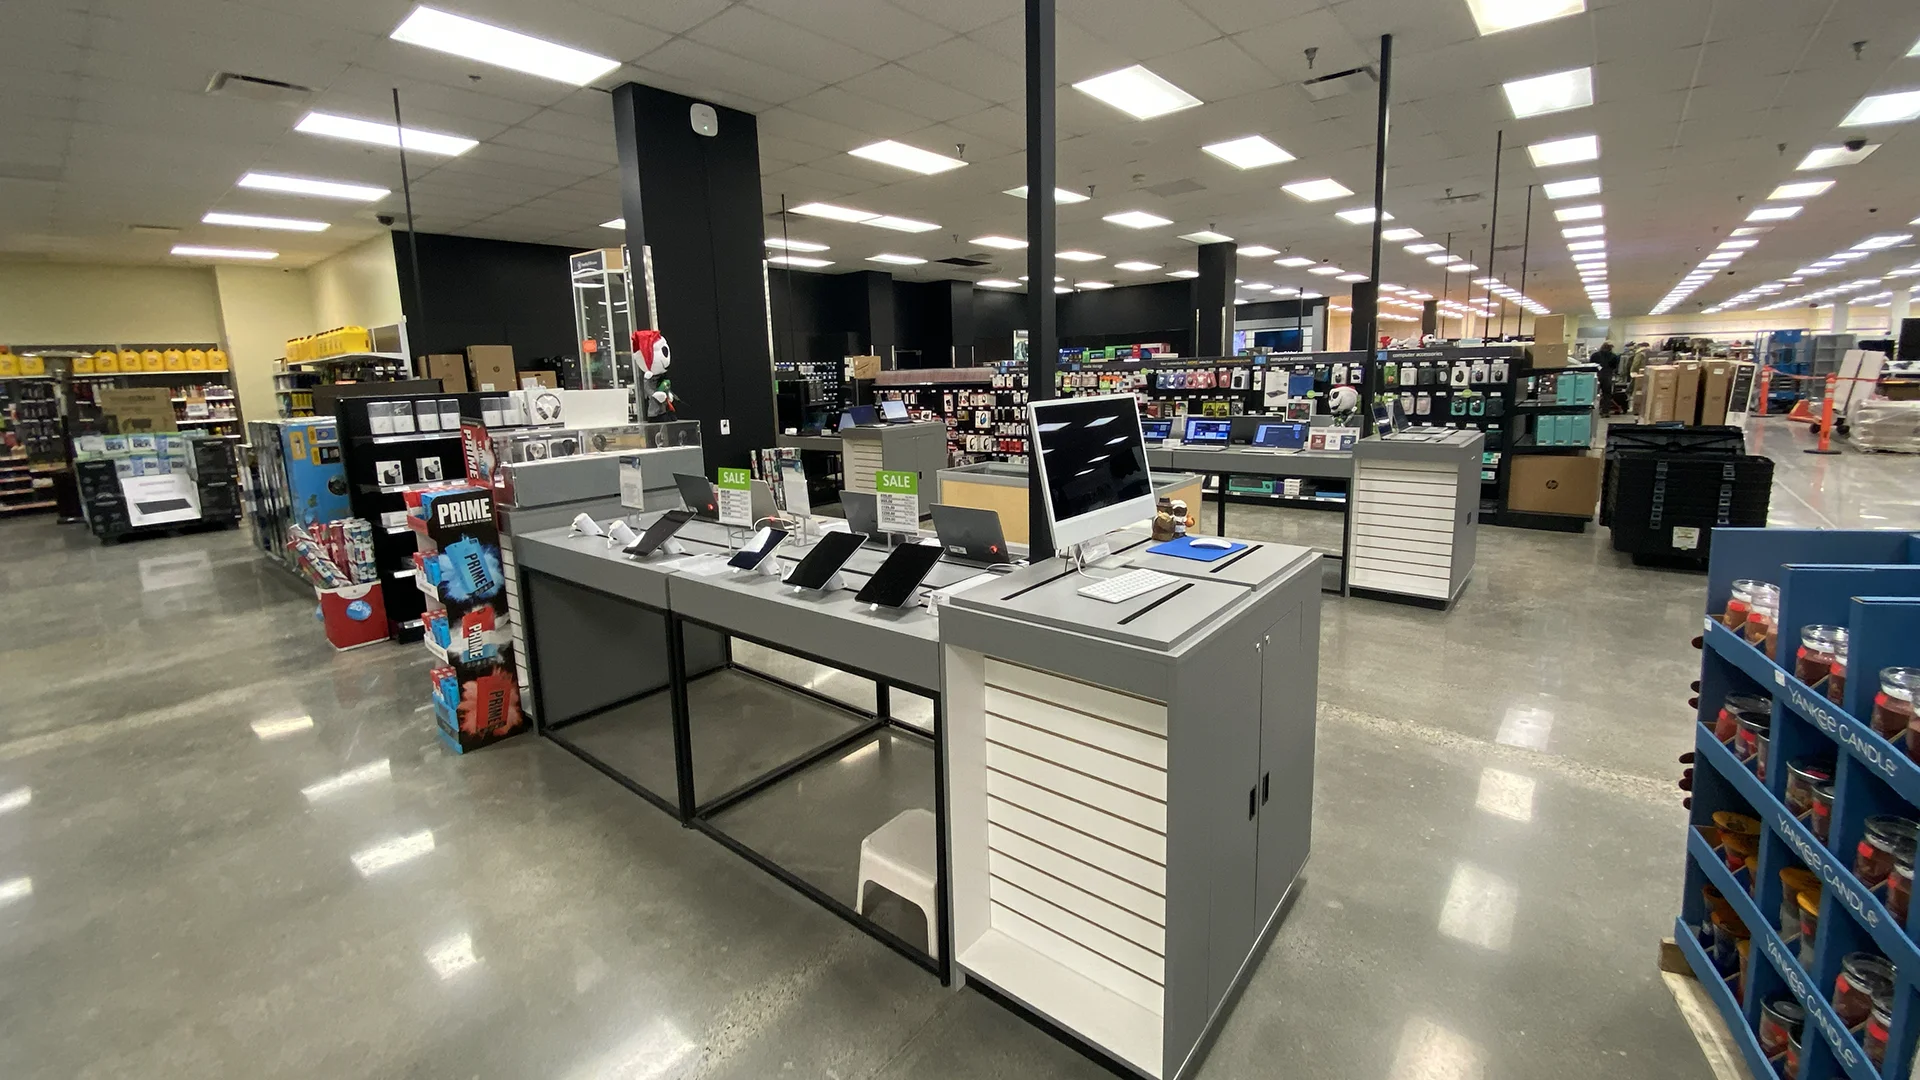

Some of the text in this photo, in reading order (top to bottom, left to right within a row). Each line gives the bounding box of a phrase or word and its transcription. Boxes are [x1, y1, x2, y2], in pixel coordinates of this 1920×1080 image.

[463, 428, 479, 480] PRIME
[723, 471, 746, 485] SALE
[882, 474, 911, 488] SALE
[437, 497, 492, 526] PRIME
[464, 552, 489, 590] PRIME
[468, 622, 484, 660] PRIME
